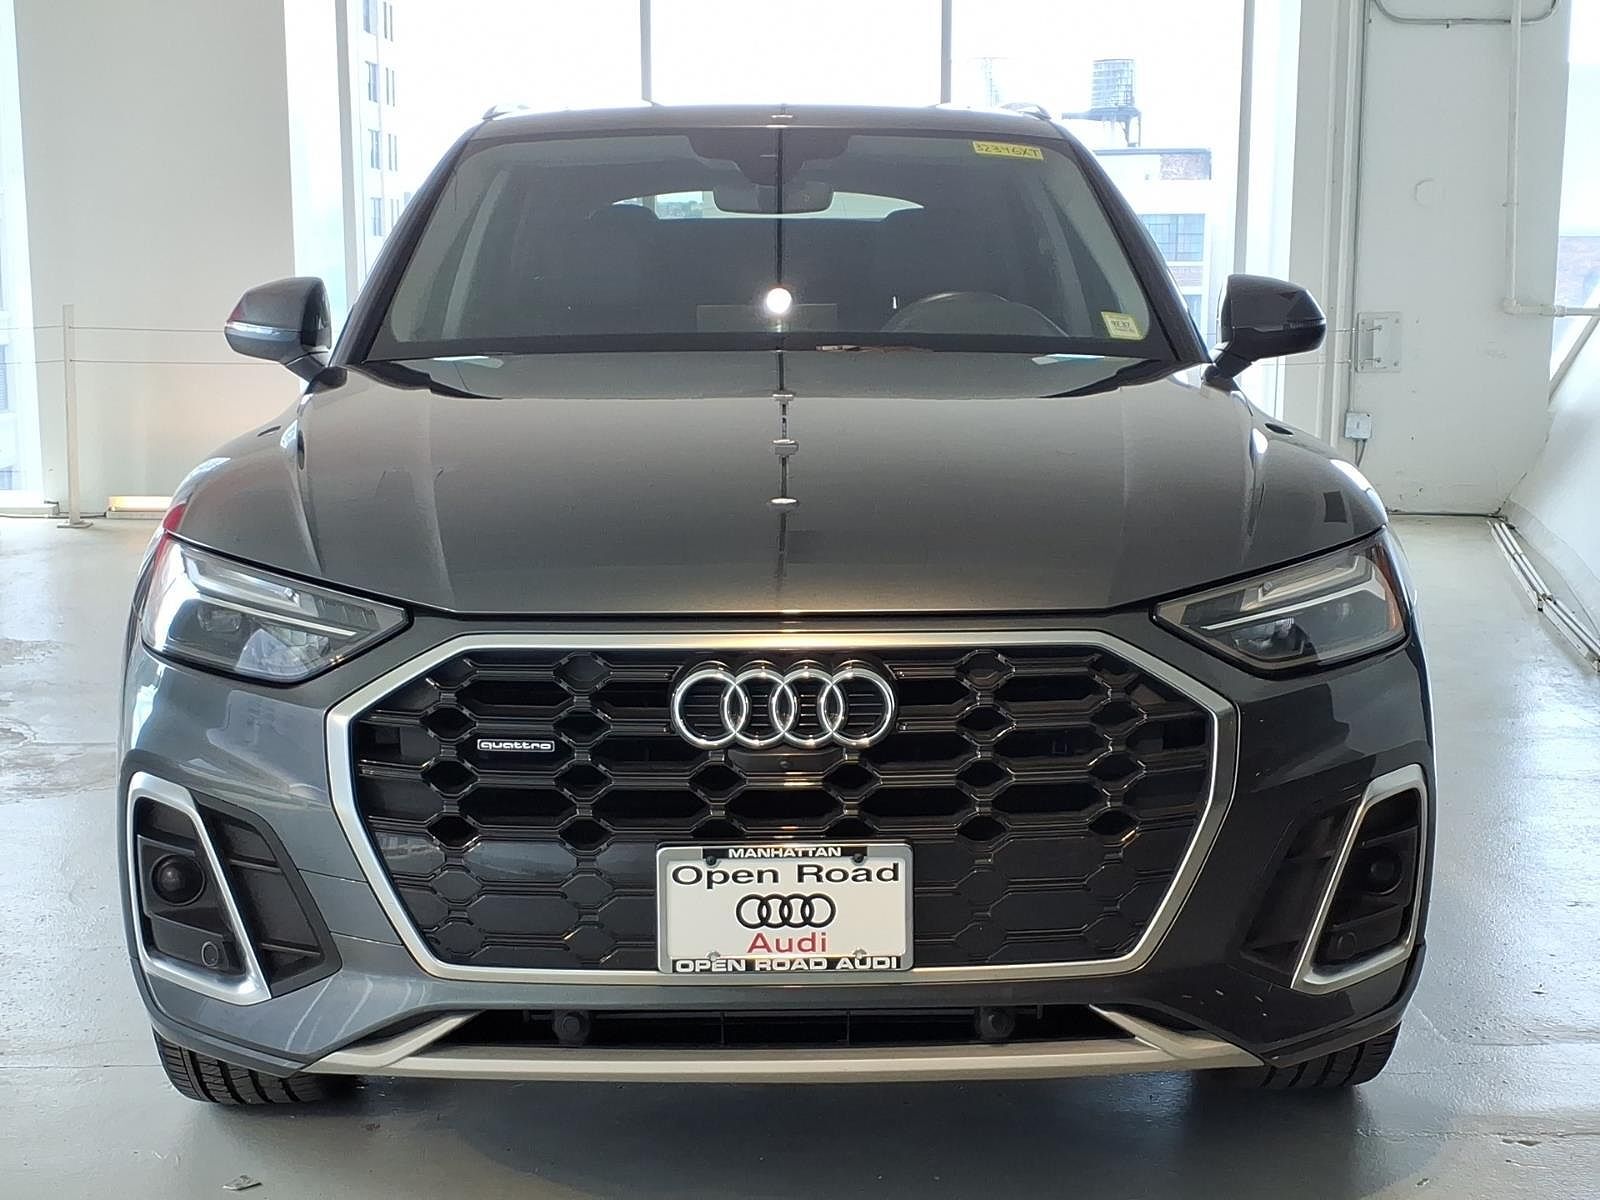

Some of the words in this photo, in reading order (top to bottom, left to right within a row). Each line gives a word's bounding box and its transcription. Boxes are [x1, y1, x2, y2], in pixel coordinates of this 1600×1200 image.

[480, 741, 552, 750] quattro
[728, 847, 842, 859] MANHATTAN
[671, 864, 780, 890] Open
[796, 862, 900, 883] Road
[746, 932, 827, 953] Audi
[675, 958, 746, 972] OPEN
[754, 957, 828, 971] ROAD
[835, 956, 898, 970] AUDI
